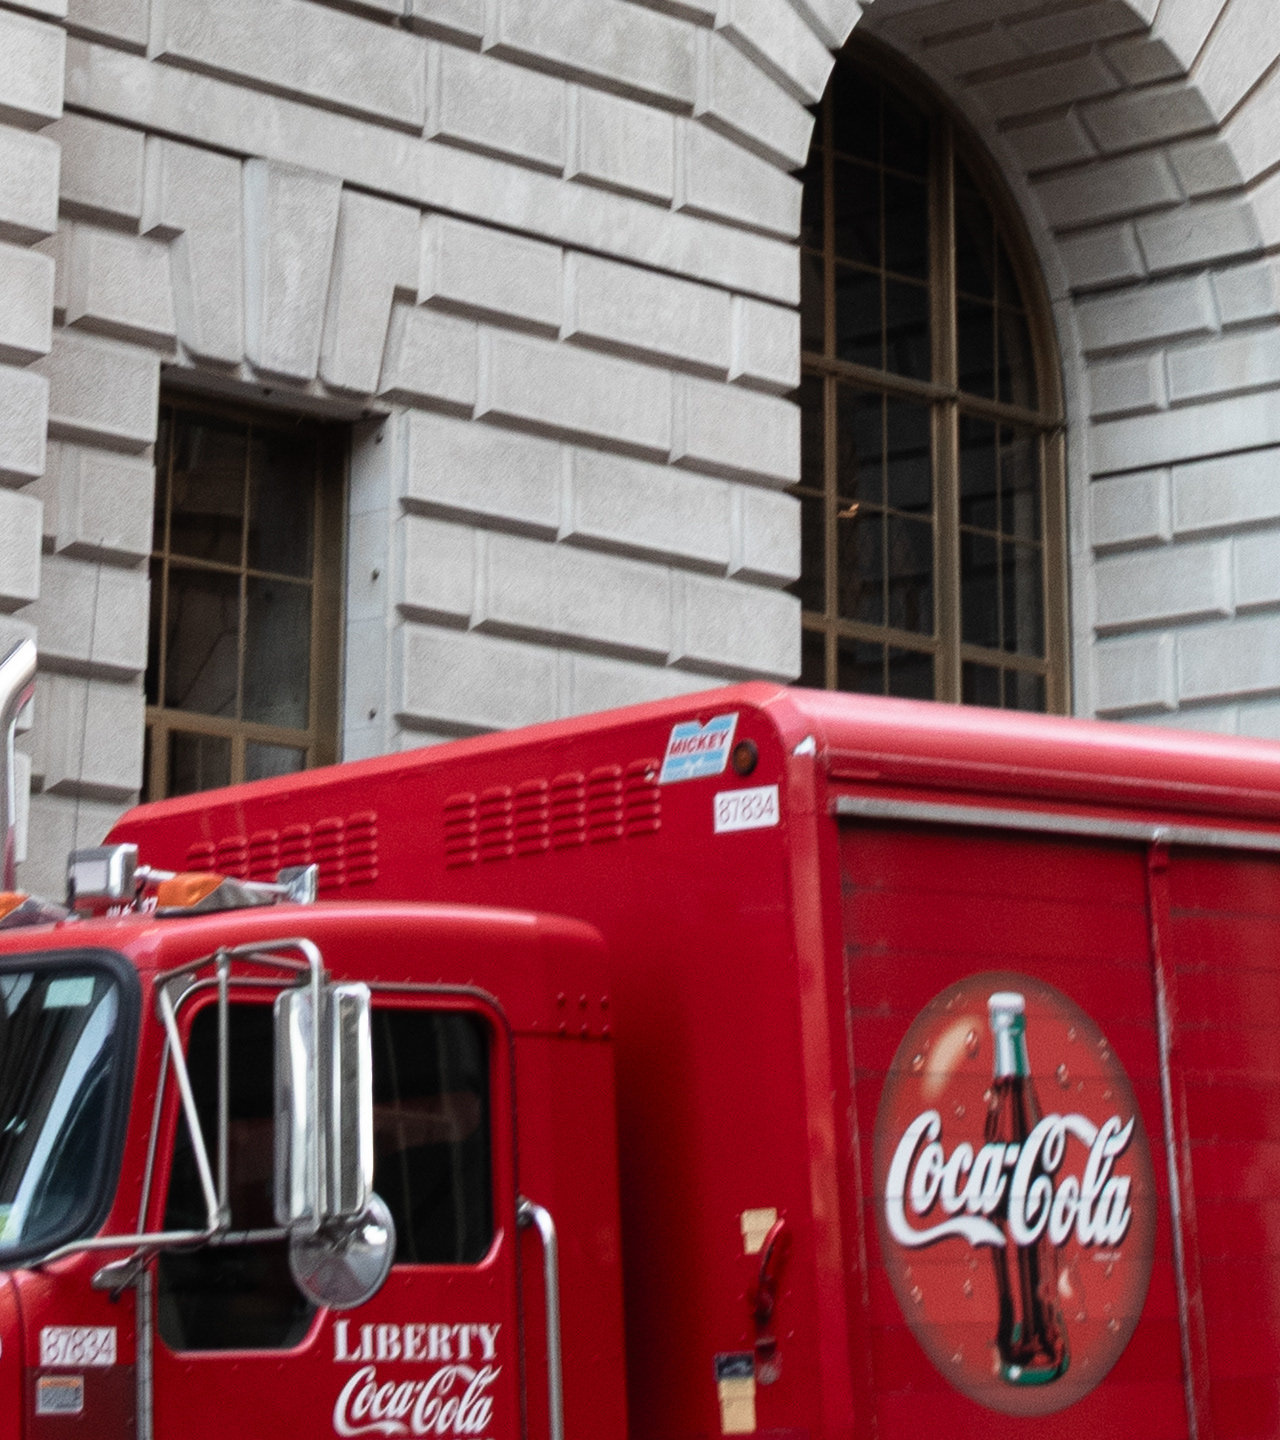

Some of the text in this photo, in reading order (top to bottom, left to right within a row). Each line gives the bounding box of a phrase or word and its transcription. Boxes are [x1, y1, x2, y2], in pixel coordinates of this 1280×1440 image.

[669, 729, 730, 756] MICKEY
[719, 791, 775, 825] 87834
[886, 1109, 1136, 1248] Coca-Cola
[46, 1327, 115, 1364] 87834
[333, 1319, 502, 1362] LIBERTY
[333, 1365, 503, 1438] Coca-Cola
